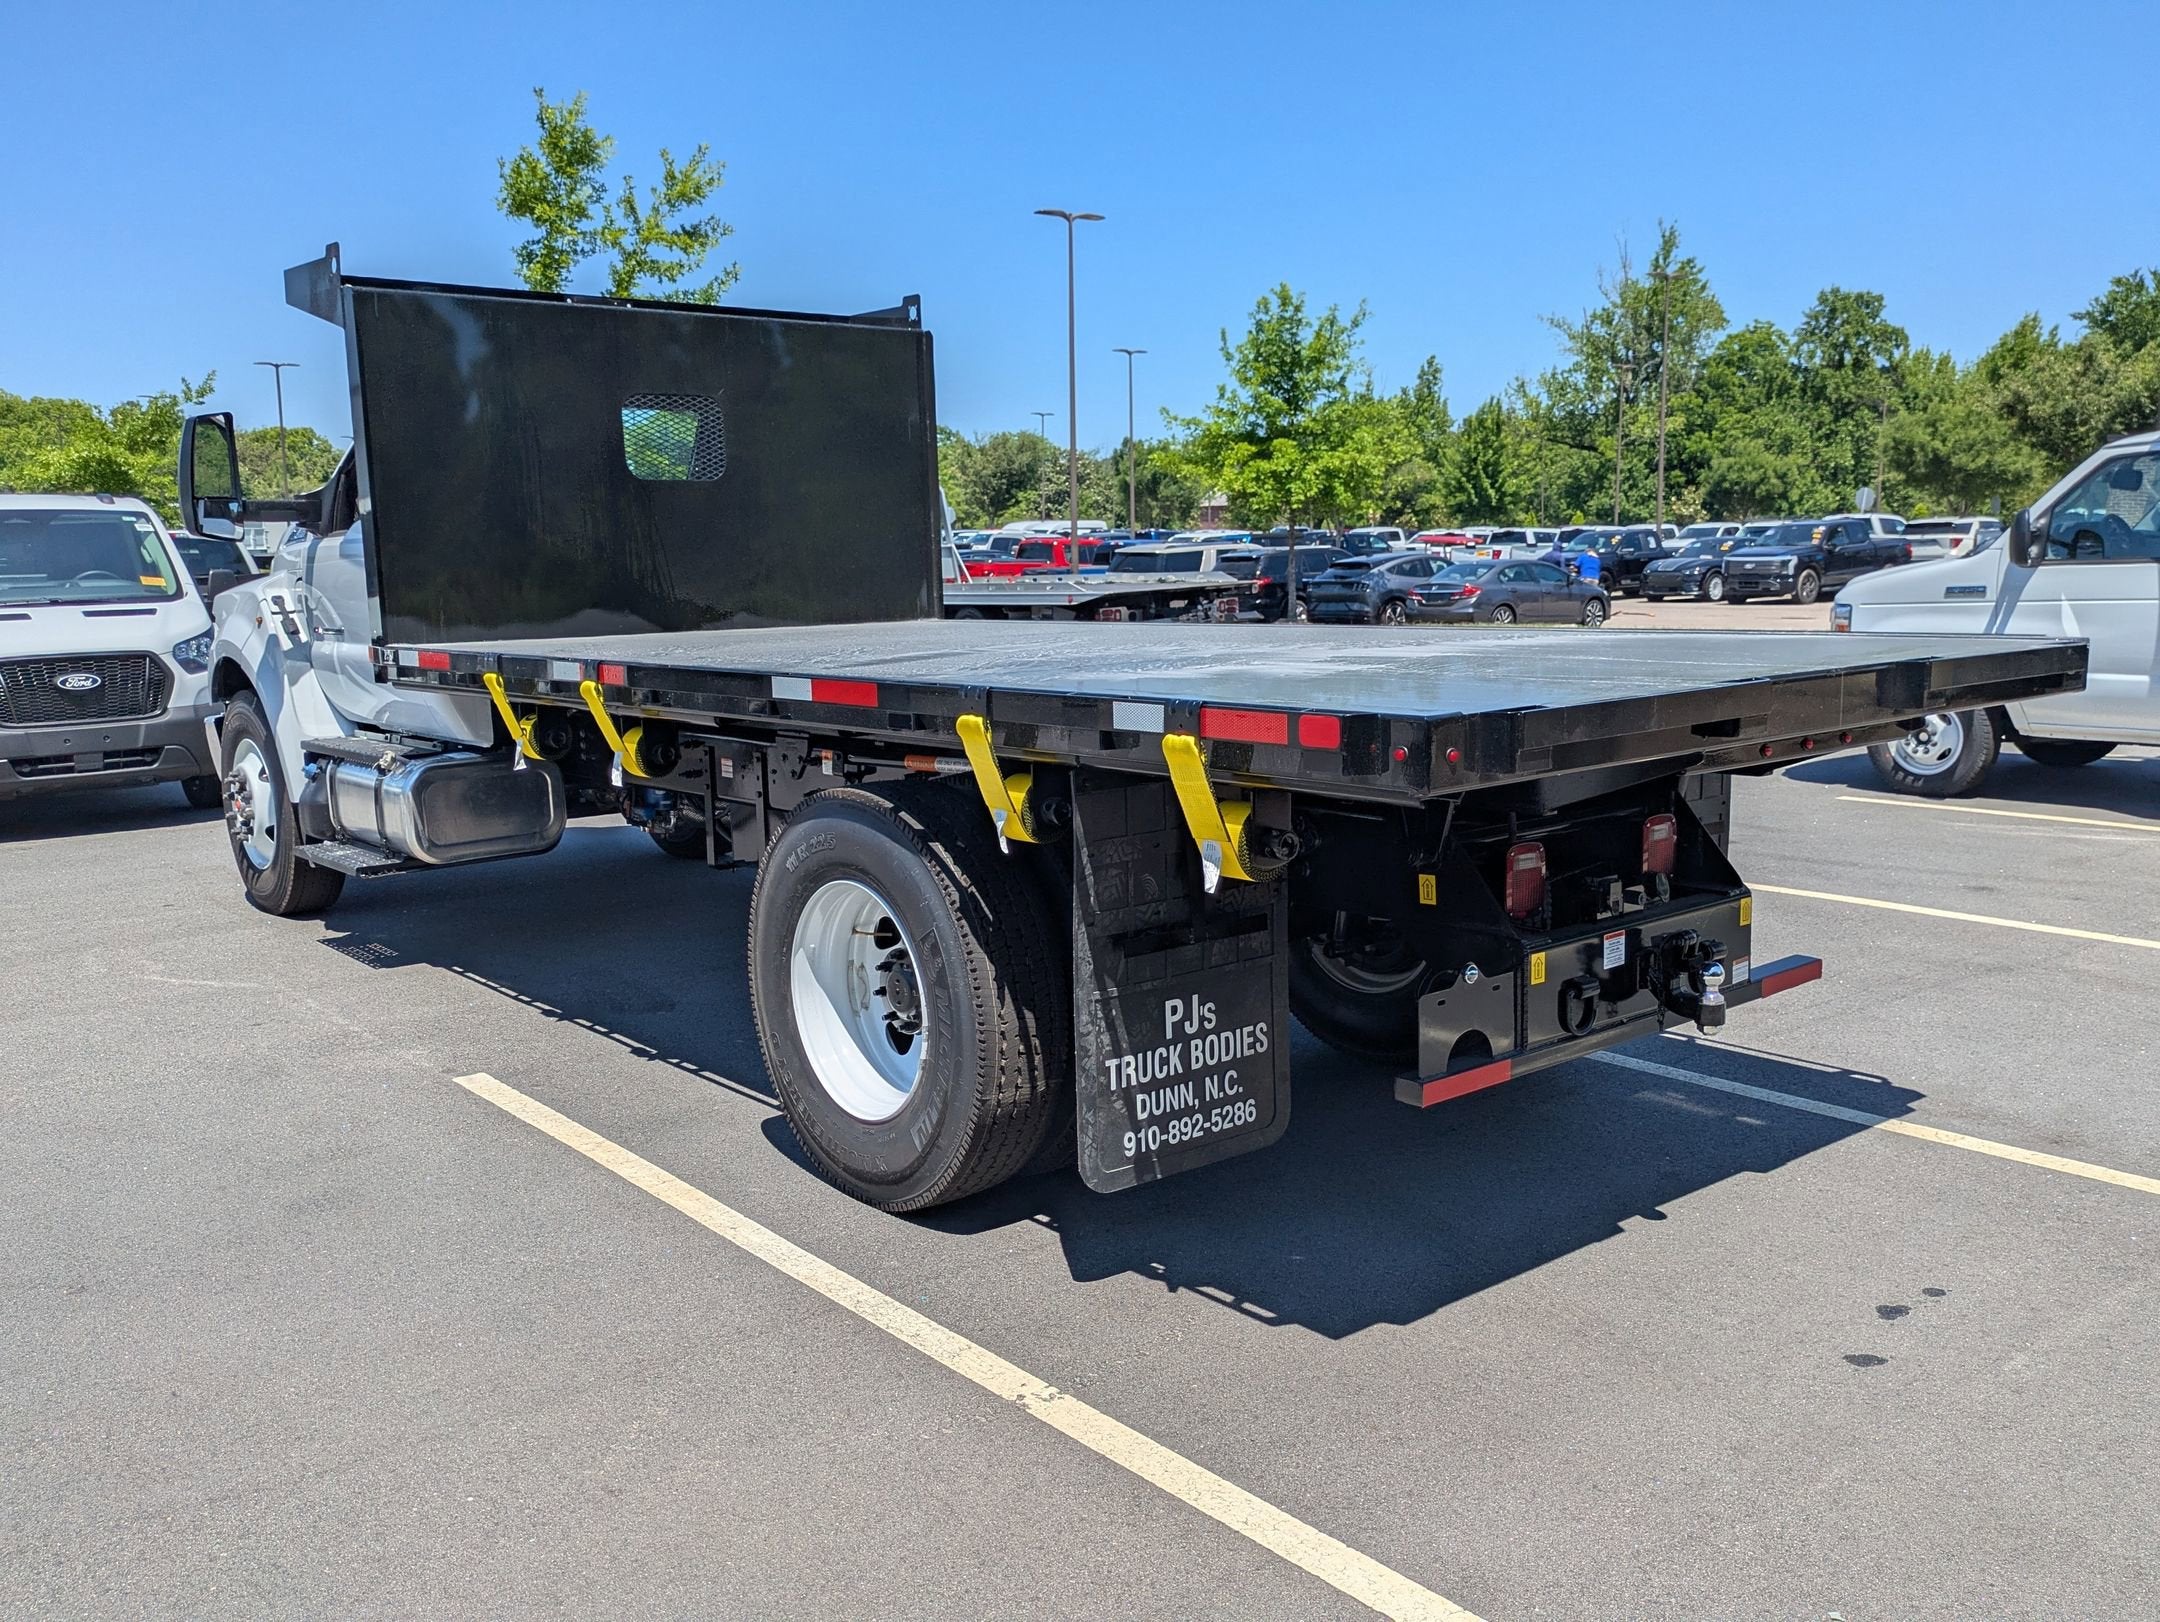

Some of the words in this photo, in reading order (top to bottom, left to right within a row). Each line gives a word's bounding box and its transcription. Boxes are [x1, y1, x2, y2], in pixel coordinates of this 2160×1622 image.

[65, 676, 94, 688] Ford
[1105, 1043, 1184, 1091] TRUCK
[1190, 1021, 1269, 1070] BODIES
[1136, 1081, 1199, 1121] DUNN,
[1205, 1069, 1243, 1101] N.C.
[1123, 1098, 1257, 1157] 910-892-5286
